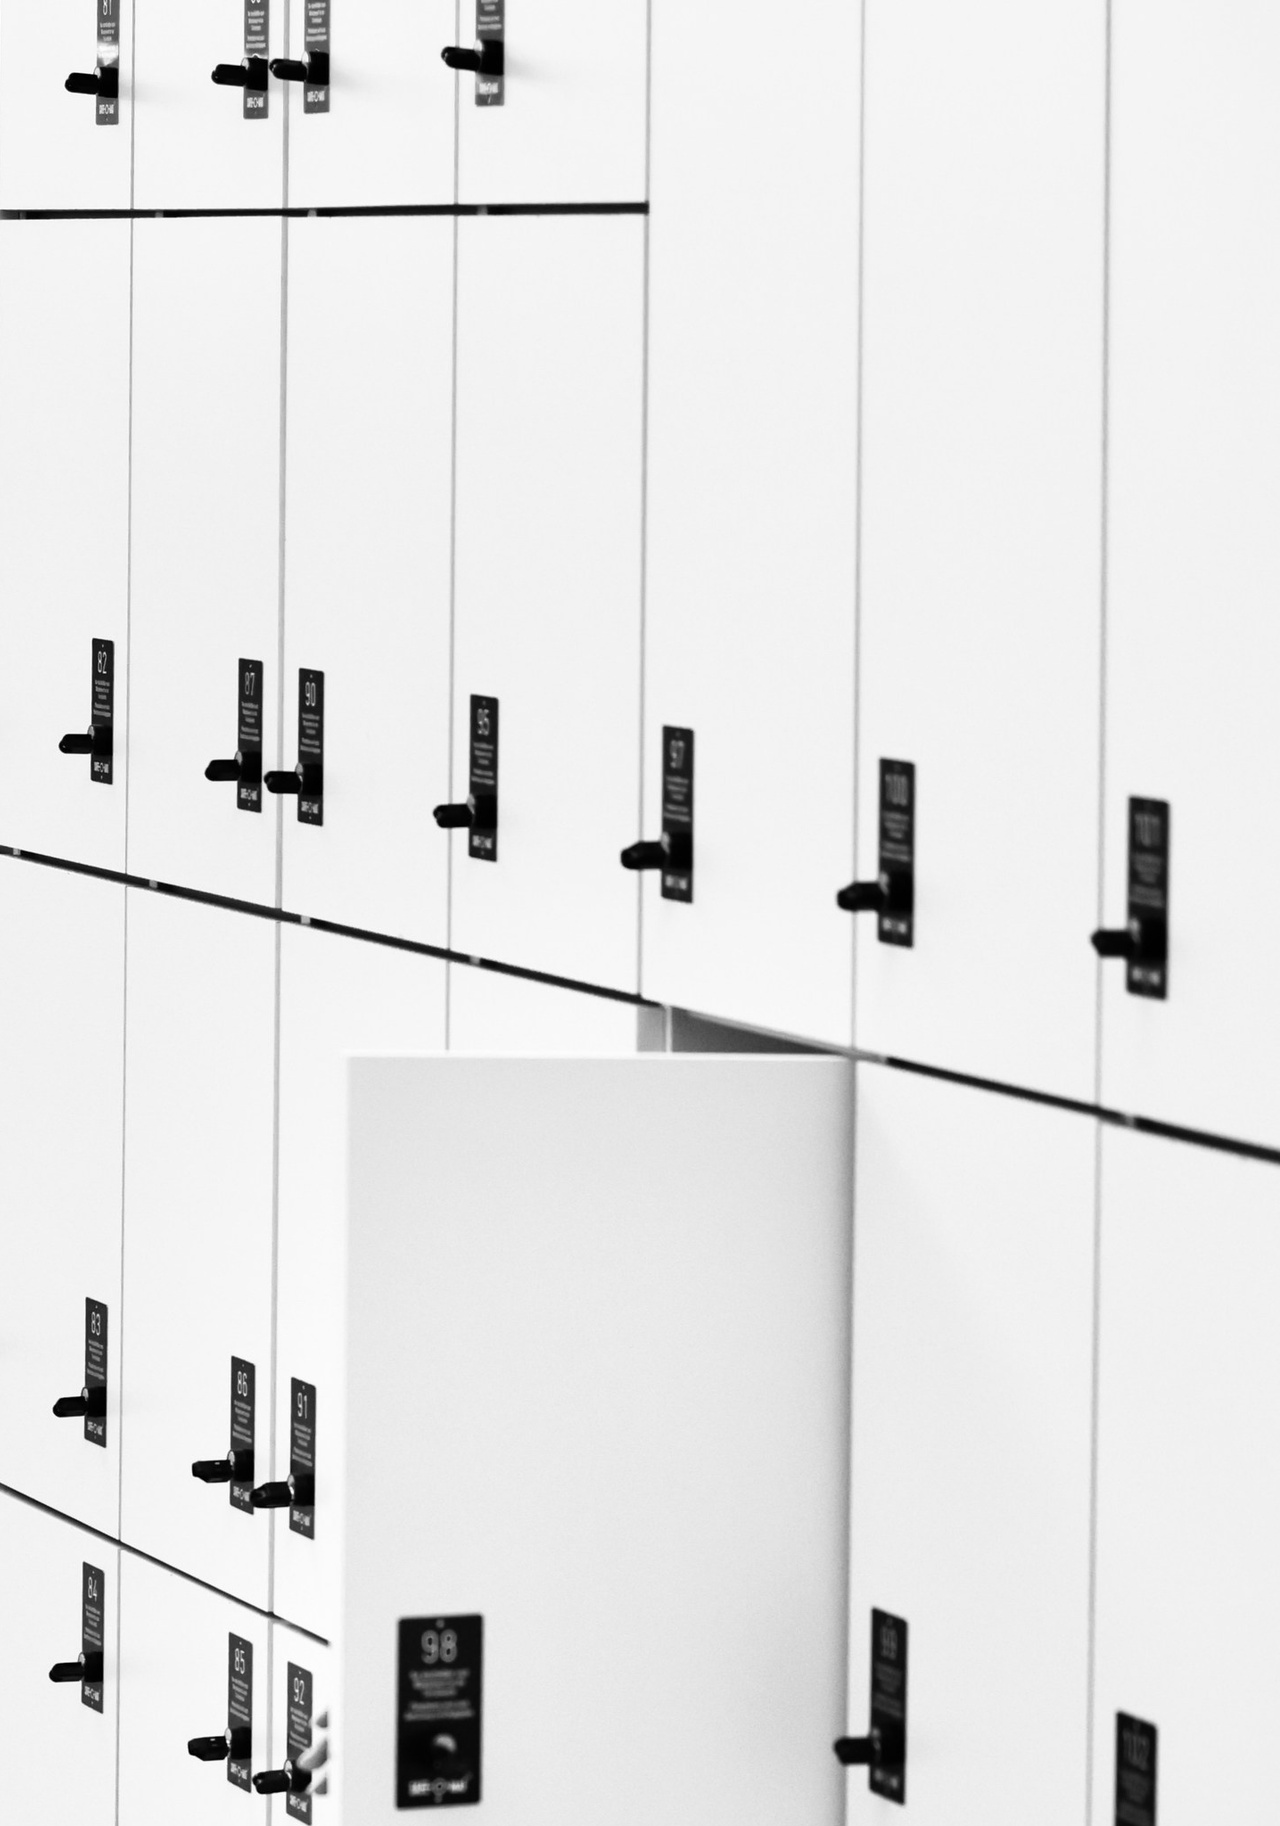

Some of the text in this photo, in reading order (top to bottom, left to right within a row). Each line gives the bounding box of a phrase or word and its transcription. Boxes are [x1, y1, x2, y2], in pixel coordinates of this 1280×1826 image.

[98, 651, 107, 674] 82
[245, 672, 255, 696] 87
[305, 682, 316, 706] 90
[91, 1312, 101, 1336] 83
[237, 1371, 248, 1397] 86
[297, 1392, 307, 1419] 91
[87, 1576, 98, 1602] 84
[421, 1629, 458, 1664] 98
[234, 1647, 245, 1674] 85
[293, 1677, 304, 1705] 92
